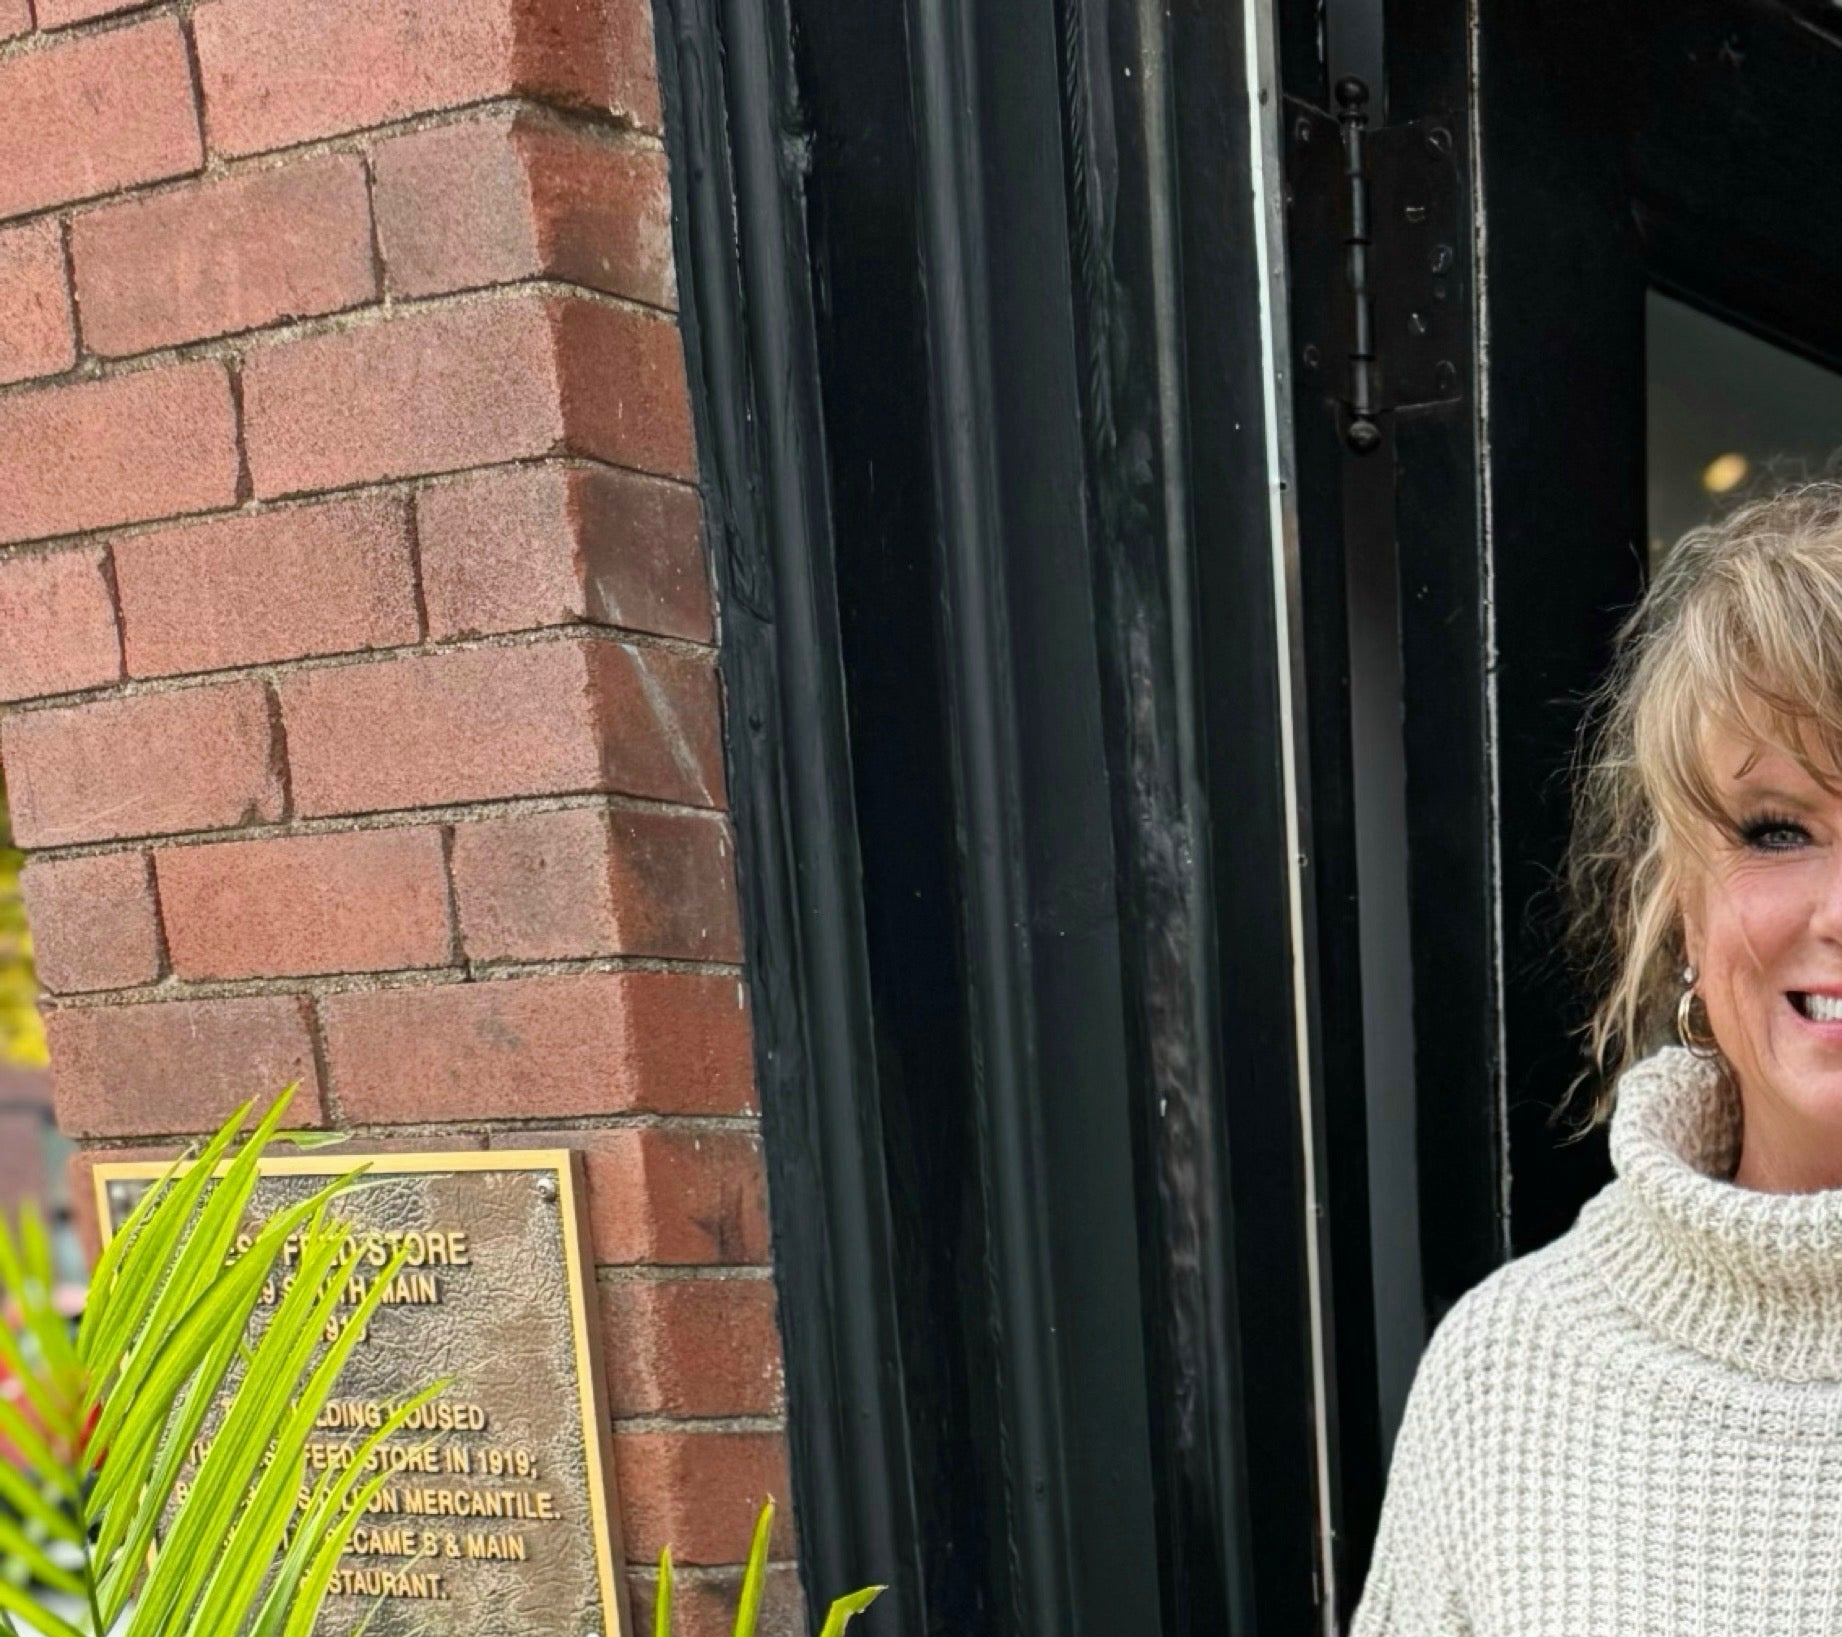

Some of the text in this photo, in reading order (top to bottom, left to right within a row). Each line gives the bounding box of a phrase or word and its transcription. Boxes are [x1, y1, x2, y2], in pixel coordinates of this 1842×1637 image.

[367, 1231, 469, 1266] STORE
[365, 1446, 440, 1473] STORE
[446, 1447, 470, 1473] IN
[478, 1449, 539, 1480] 1919;
[405, 1488, 561, 1520] MERCANTILE.
[423, 1532, 438, 1557] B
[446, 1533, 461, 1558] &
[466, 1533, 526, 1560] MAIN
[301, 1569, 447, 1600] STAURANT.
